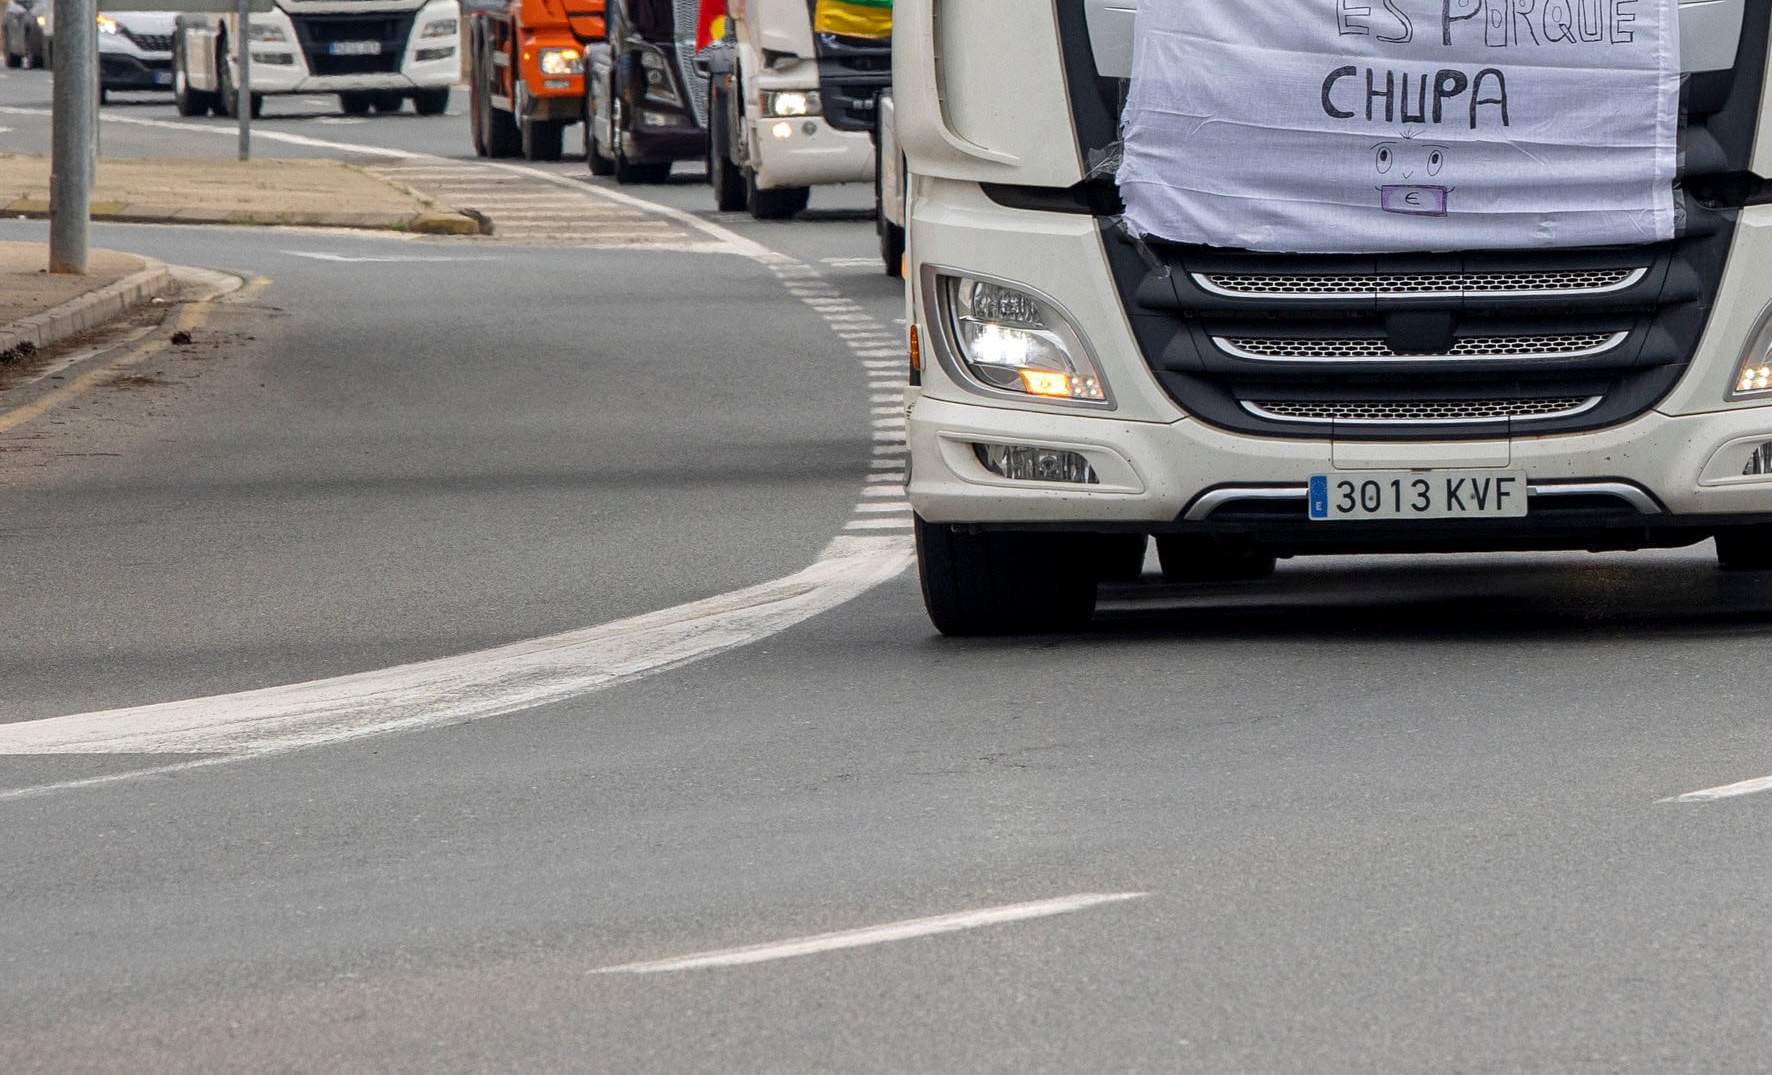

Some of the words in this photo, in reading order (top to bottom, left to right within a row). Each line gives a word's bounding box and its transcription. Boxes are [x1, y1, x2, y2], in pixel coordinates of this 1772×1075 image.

[1321, 65, 1510, 129] CHUPA
[1335, 478, 1431, 513] 3013
[1446, 477, 1516, 512] KVF
